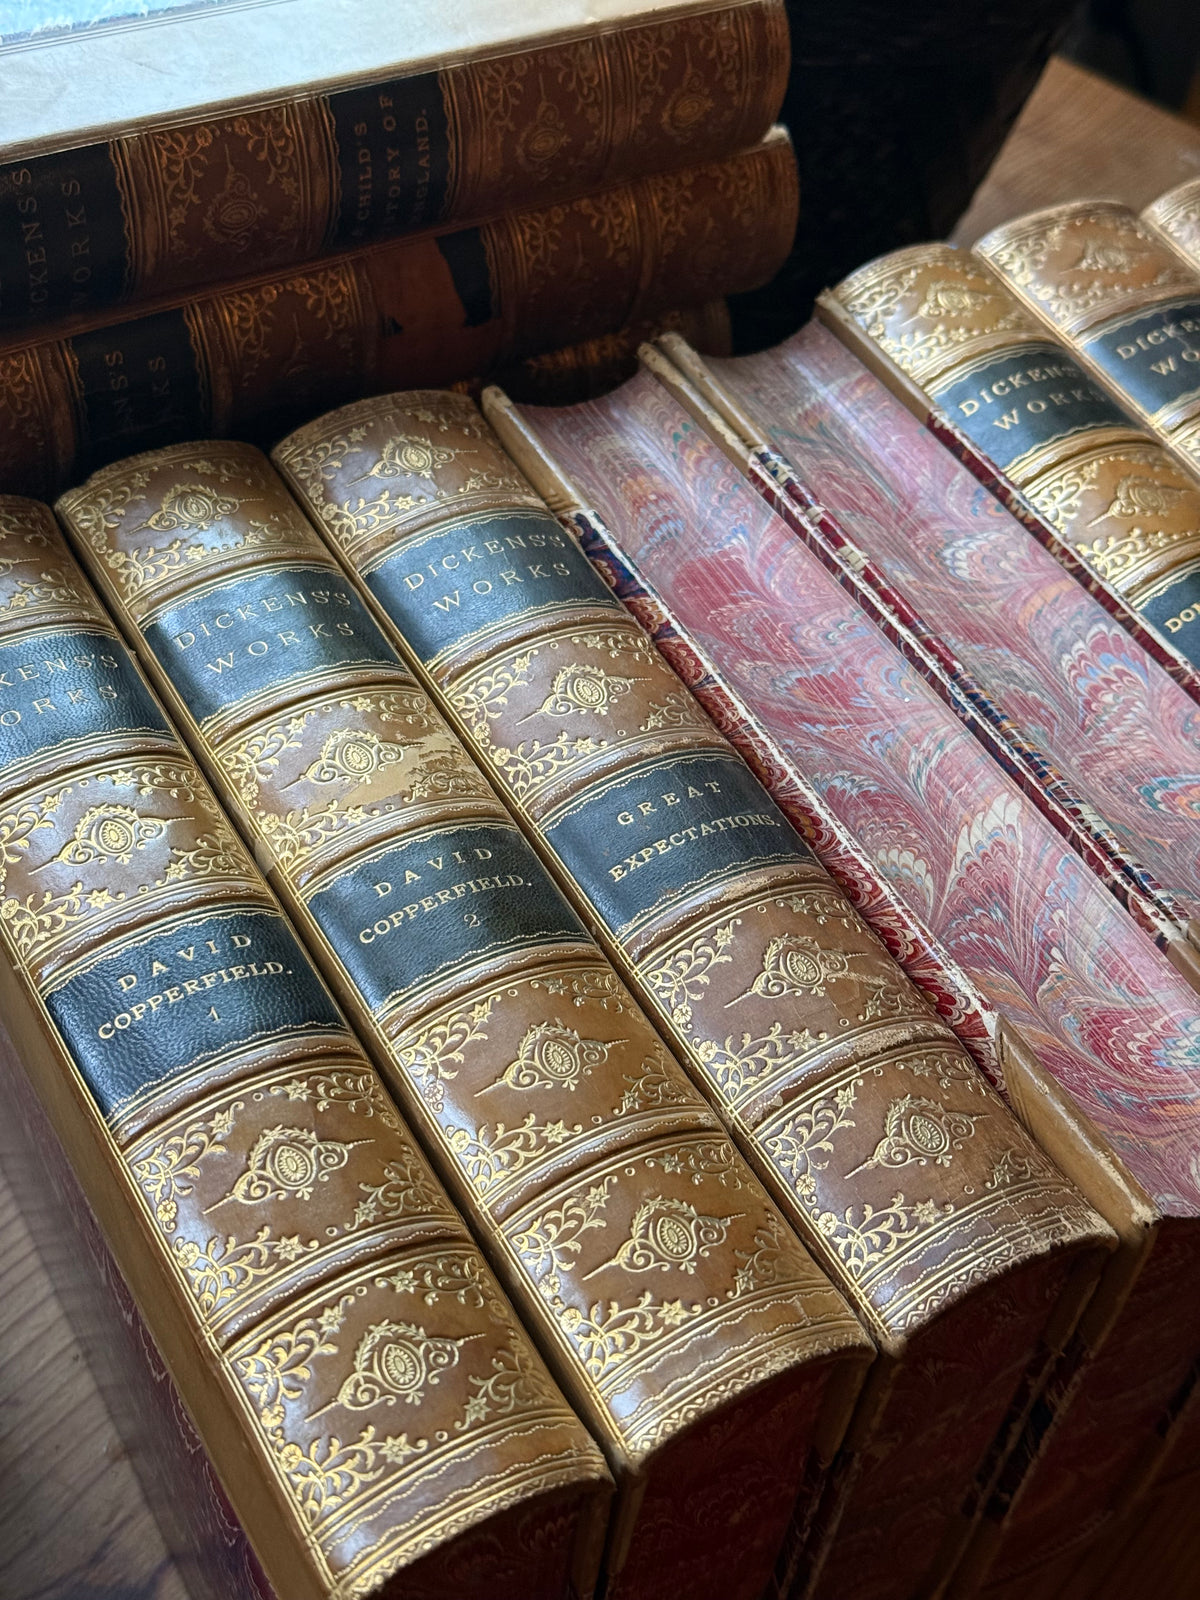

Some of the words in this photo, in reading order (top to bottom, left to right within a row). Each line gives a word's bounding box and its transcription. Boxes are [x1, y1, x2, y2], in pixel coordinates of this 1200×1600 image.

[378, 94, 397, 132] OF
[1149, 355, 1200, 377] WO
[403, 533, 566, 592] DICKENS'S
[432, 562, 571, 613] WORKS
[175, 590, 351, 651] DICKENS'S
[0, 653, 119, 690] KENS'S
[206, 622, 355, 675] WORKS
[0, 685, 118, 726] ORKS
[616, 780, 722, 826] GREAT
[373, 847, 493, 898] DAVID
[607, 813, 782, 883] EXPECTATIONS.
[358, 874, 533, 944] COPPERFIELD.
[463, 913, 482, 929] 2
[117, 934, 252, 992] DAVID
[98, 961, 294, 1040] COPPERFIELD.
[207, 1006, 222, 1024] 1
